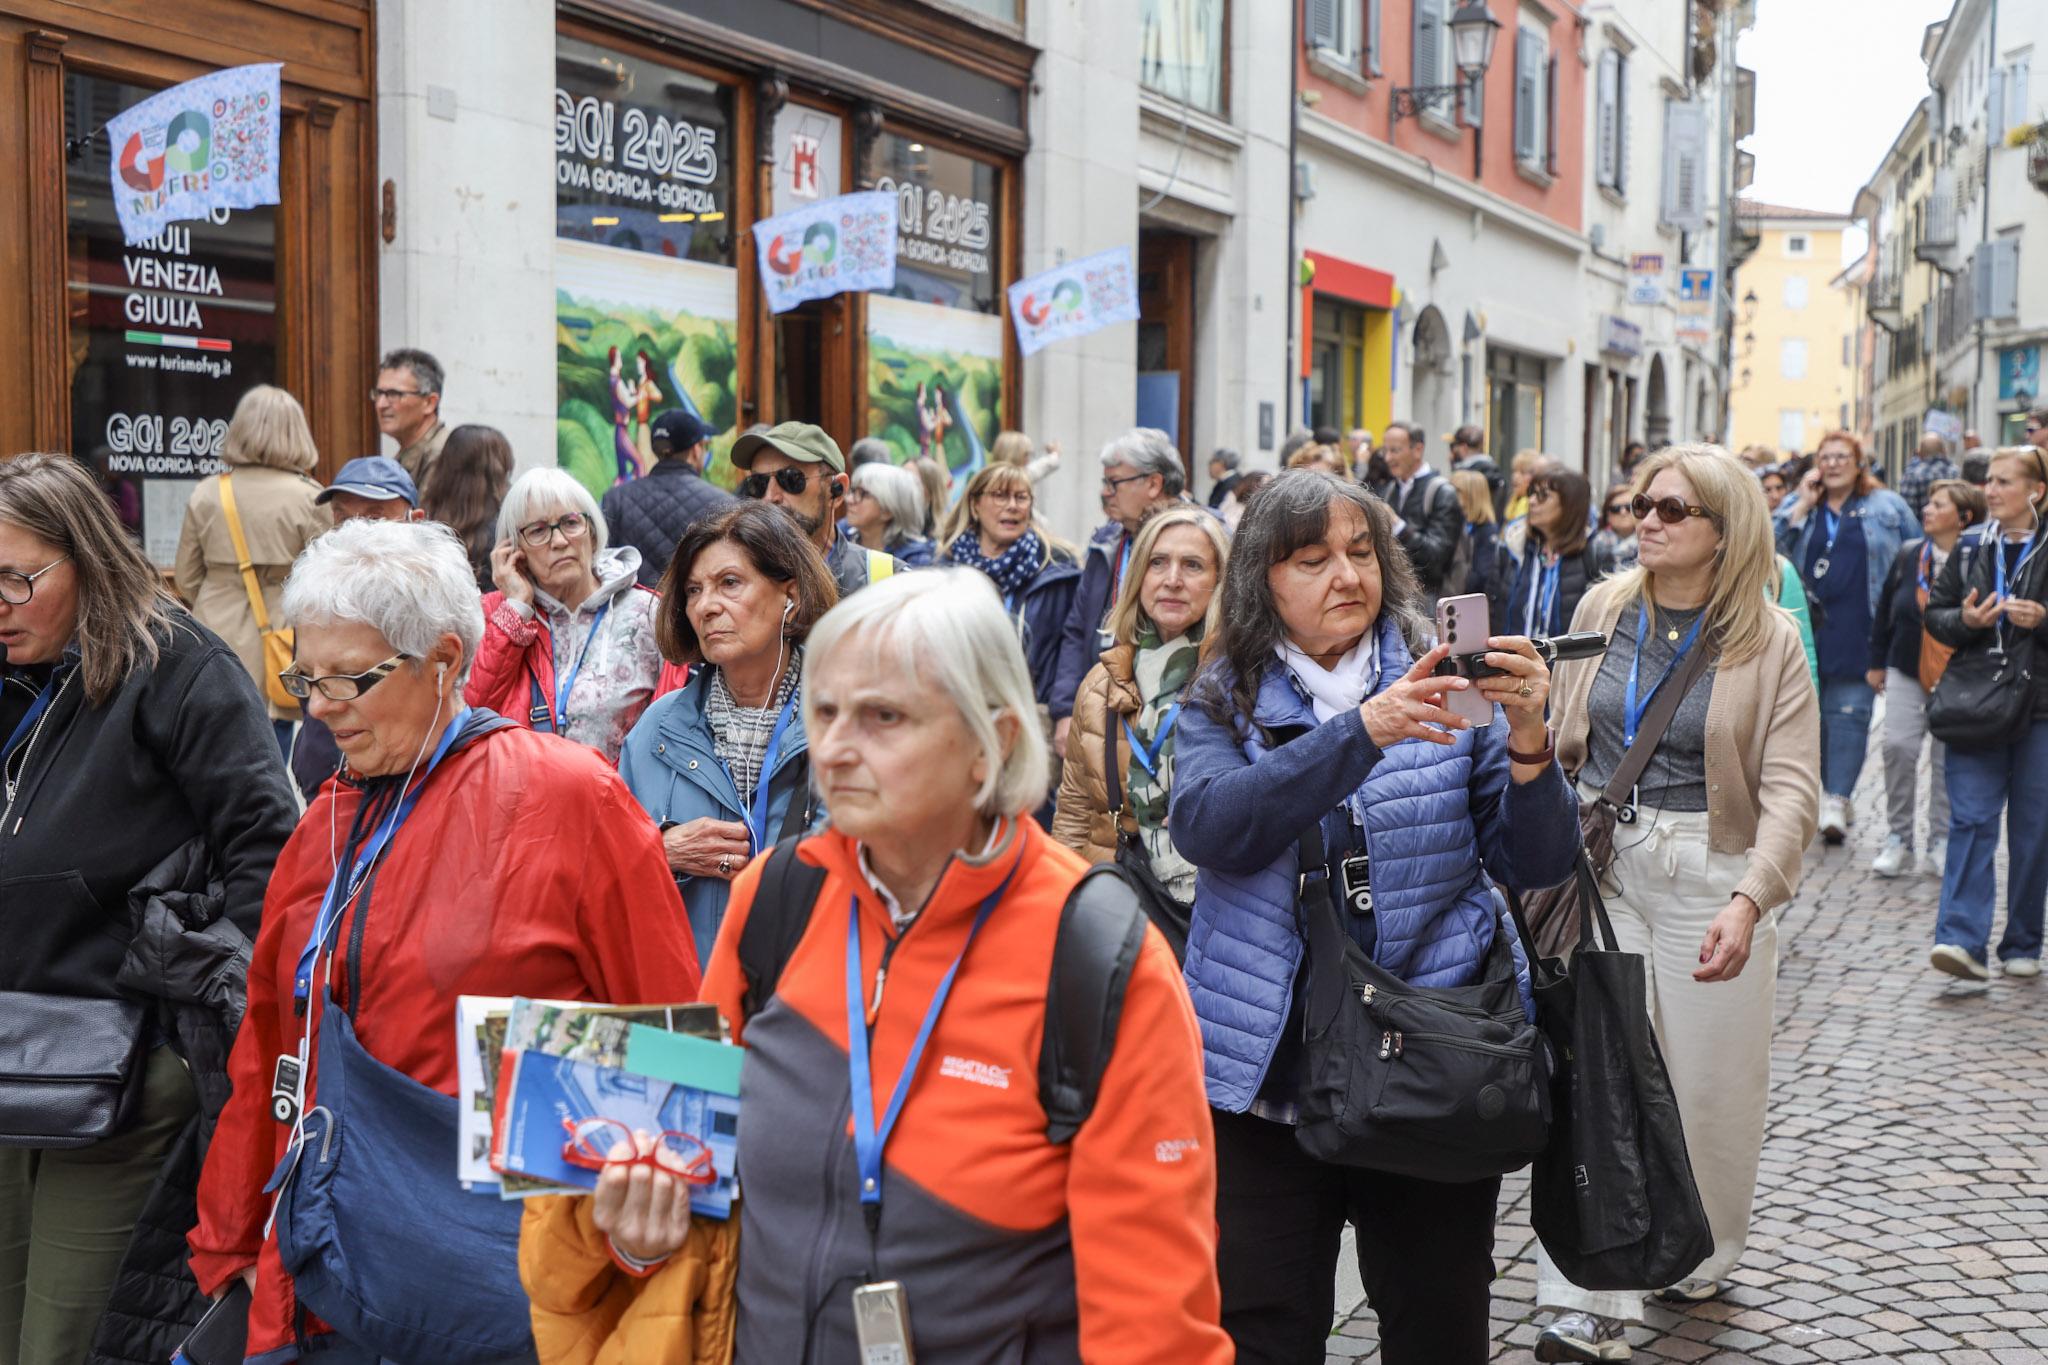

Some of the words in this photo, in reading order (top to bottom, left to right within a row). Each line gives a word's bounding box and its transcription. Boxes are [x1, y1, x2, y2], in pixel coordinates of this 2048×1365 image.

[622, 108, 718, 185] 2025
[557, 159, 591, 189] OVA
[927, 189, 990, 250] 2025
[123, 254, 223, 297] VENEZIA
[124, 292, 203, 330] GIULIA
[106, 412, 164, 454] GO!
[170, 416, 230, 457] 202
[108, 454, 145, 472] NOVA
